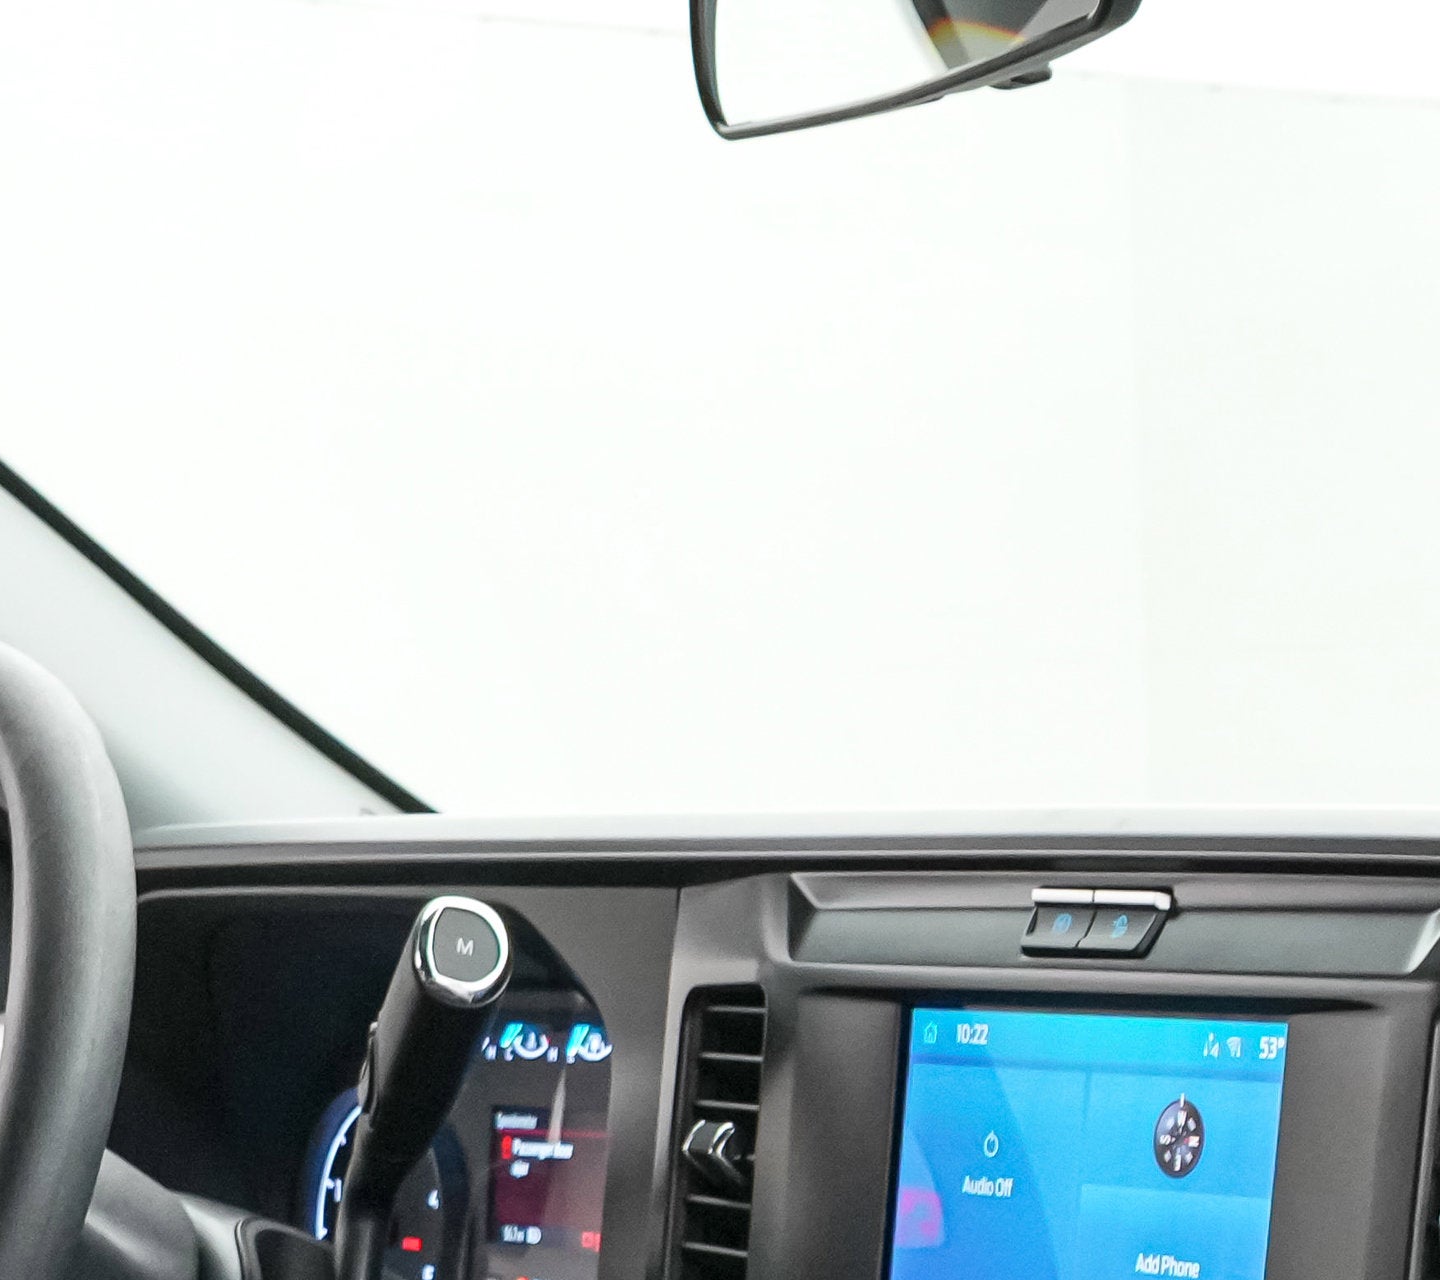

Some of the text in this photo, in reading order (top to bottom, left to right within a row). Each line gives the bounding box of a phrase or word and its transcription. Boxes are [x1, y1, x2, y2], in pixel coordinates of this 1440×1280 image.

[456, 938, 474, 956] M
[956, 1022, 989, 1046] 10:22
[1258, 1034, 1285, 1060] 53°
[962, 1175, 1013, 1198] Audio Off
[1135, 1252, 1201, 1280] Add Phone
